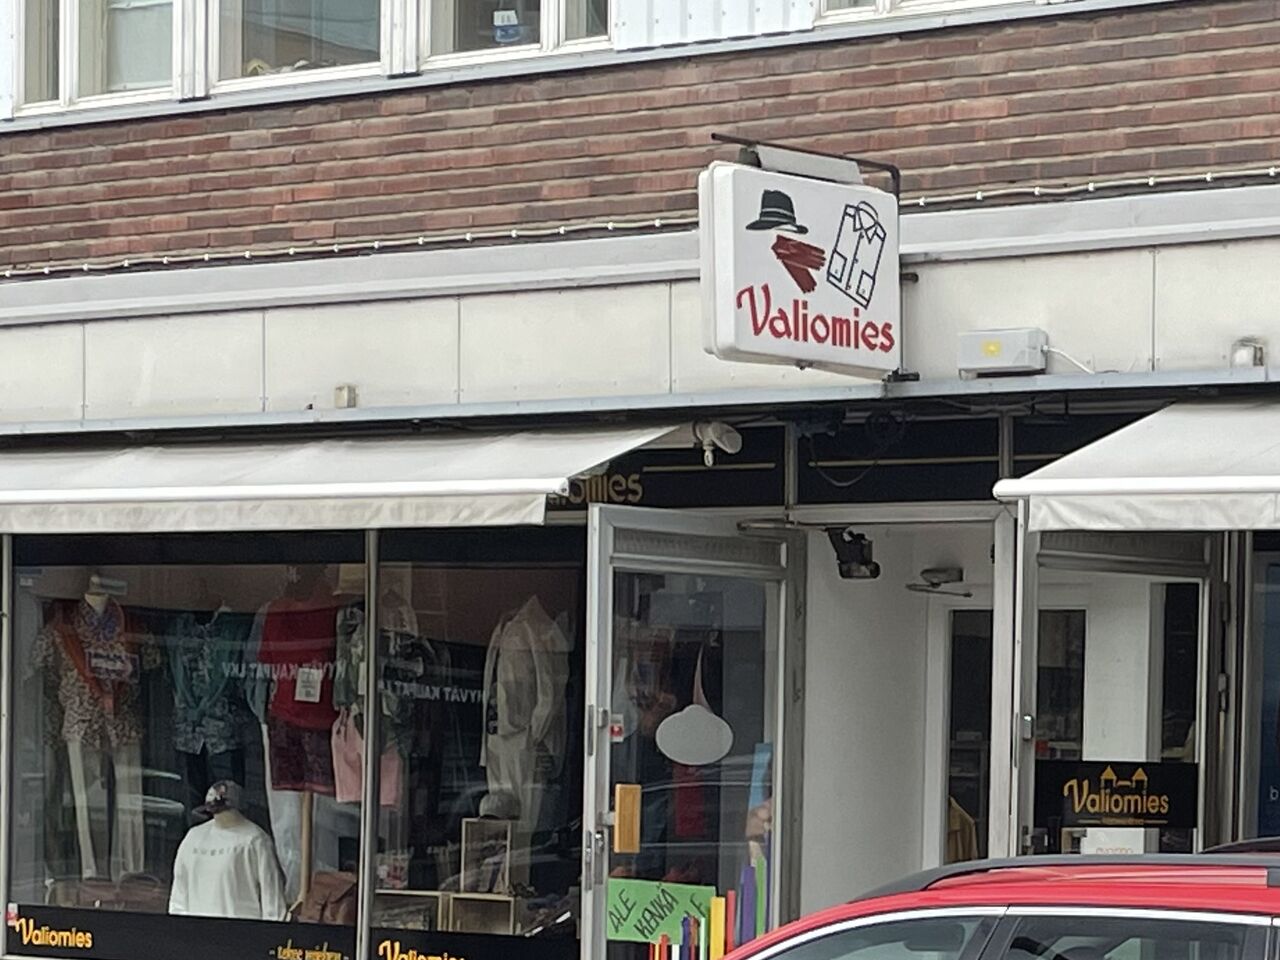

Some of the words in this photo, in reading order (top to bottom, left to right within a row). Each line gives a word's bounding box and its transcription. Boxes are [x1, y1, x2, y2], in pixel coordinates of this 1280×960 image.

[735, 283, 895, 353] Valiomies
[548, 473, 644, 505] omies
[1063, 778, 1170, 814] Valiomies
[607, 888, 637, 934] ALE
[15, 917, 93, 948] Valiomies
